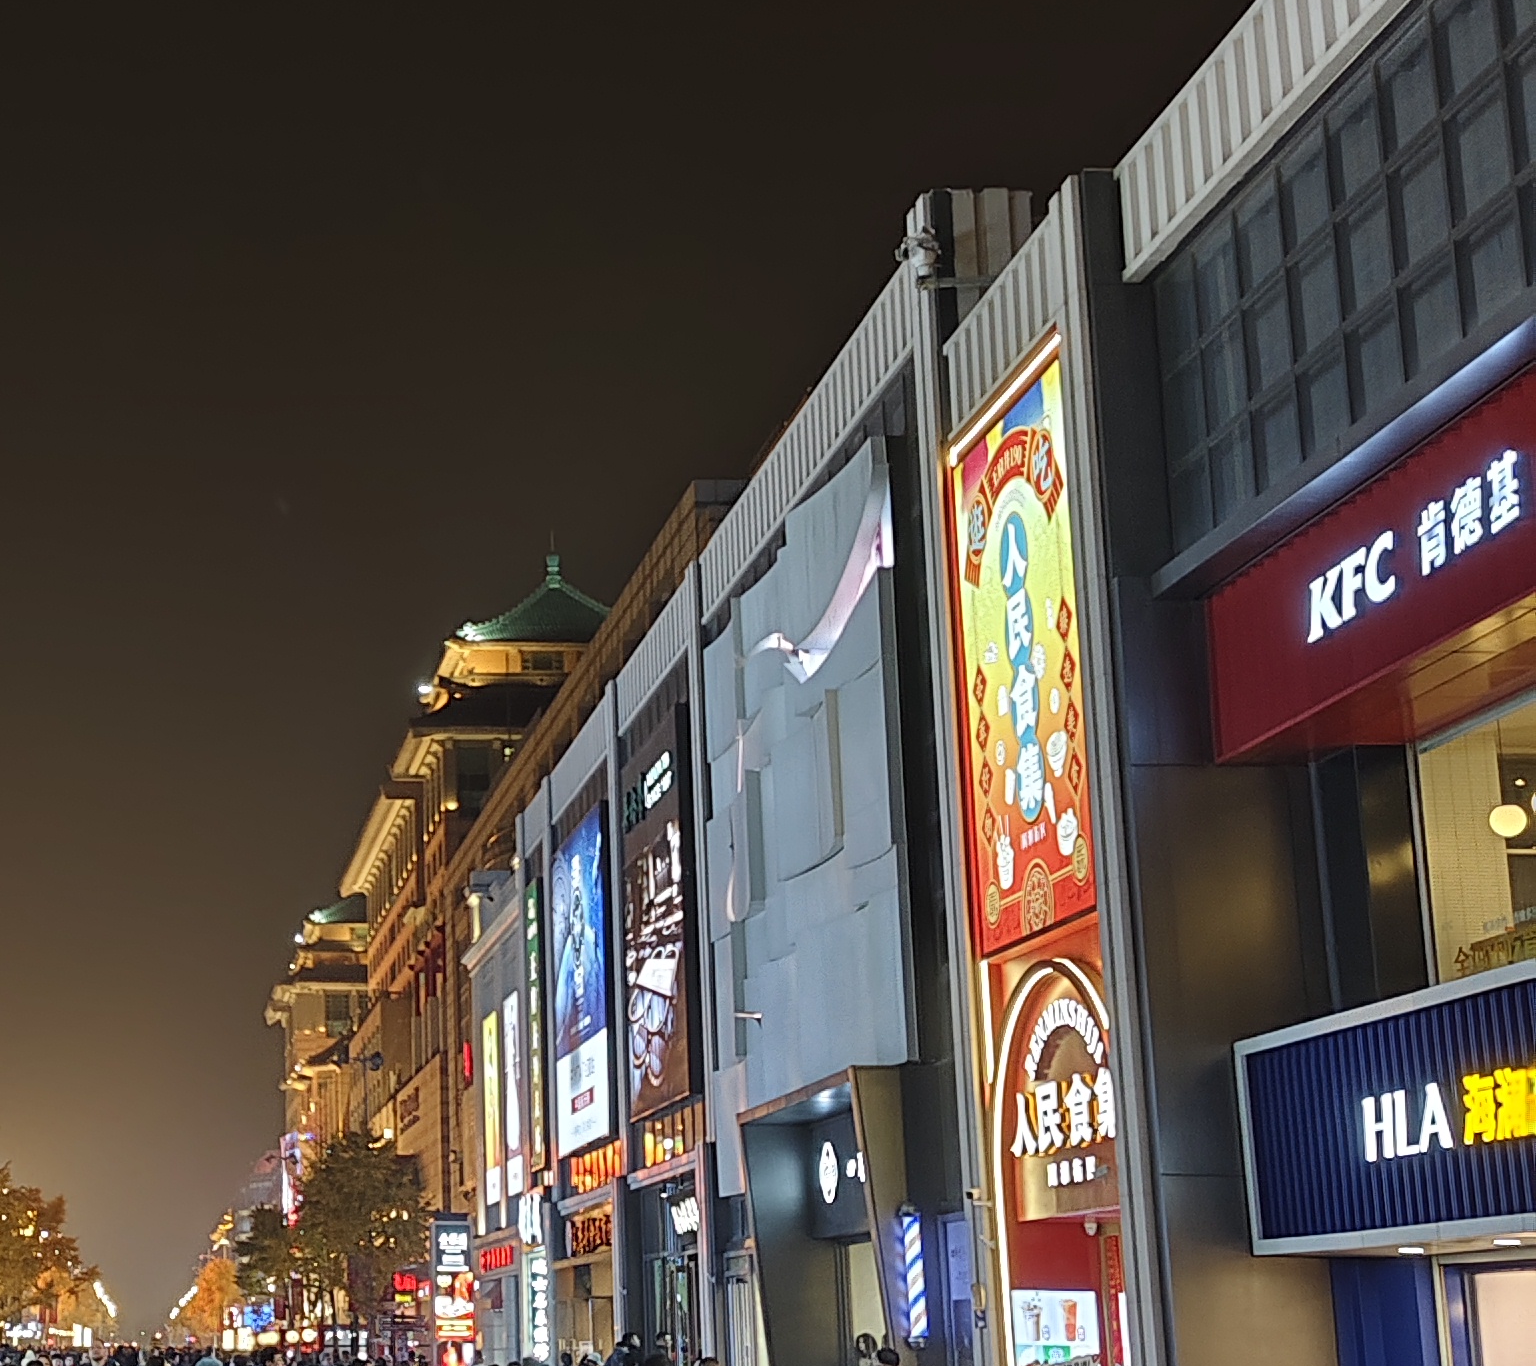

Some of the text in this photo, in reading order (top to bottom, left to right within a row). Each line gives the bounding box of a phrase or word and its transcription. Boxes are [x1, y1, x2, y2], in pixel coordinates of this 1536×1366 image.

[1307, 449, 1520, 643] KFC 肯德基
[1002, 523, 1046, 810] 人民食集
[1010, 1066, 1116, 1158] 人民食集
[1361, 1067, 1536, 1163] HLA 海澜
